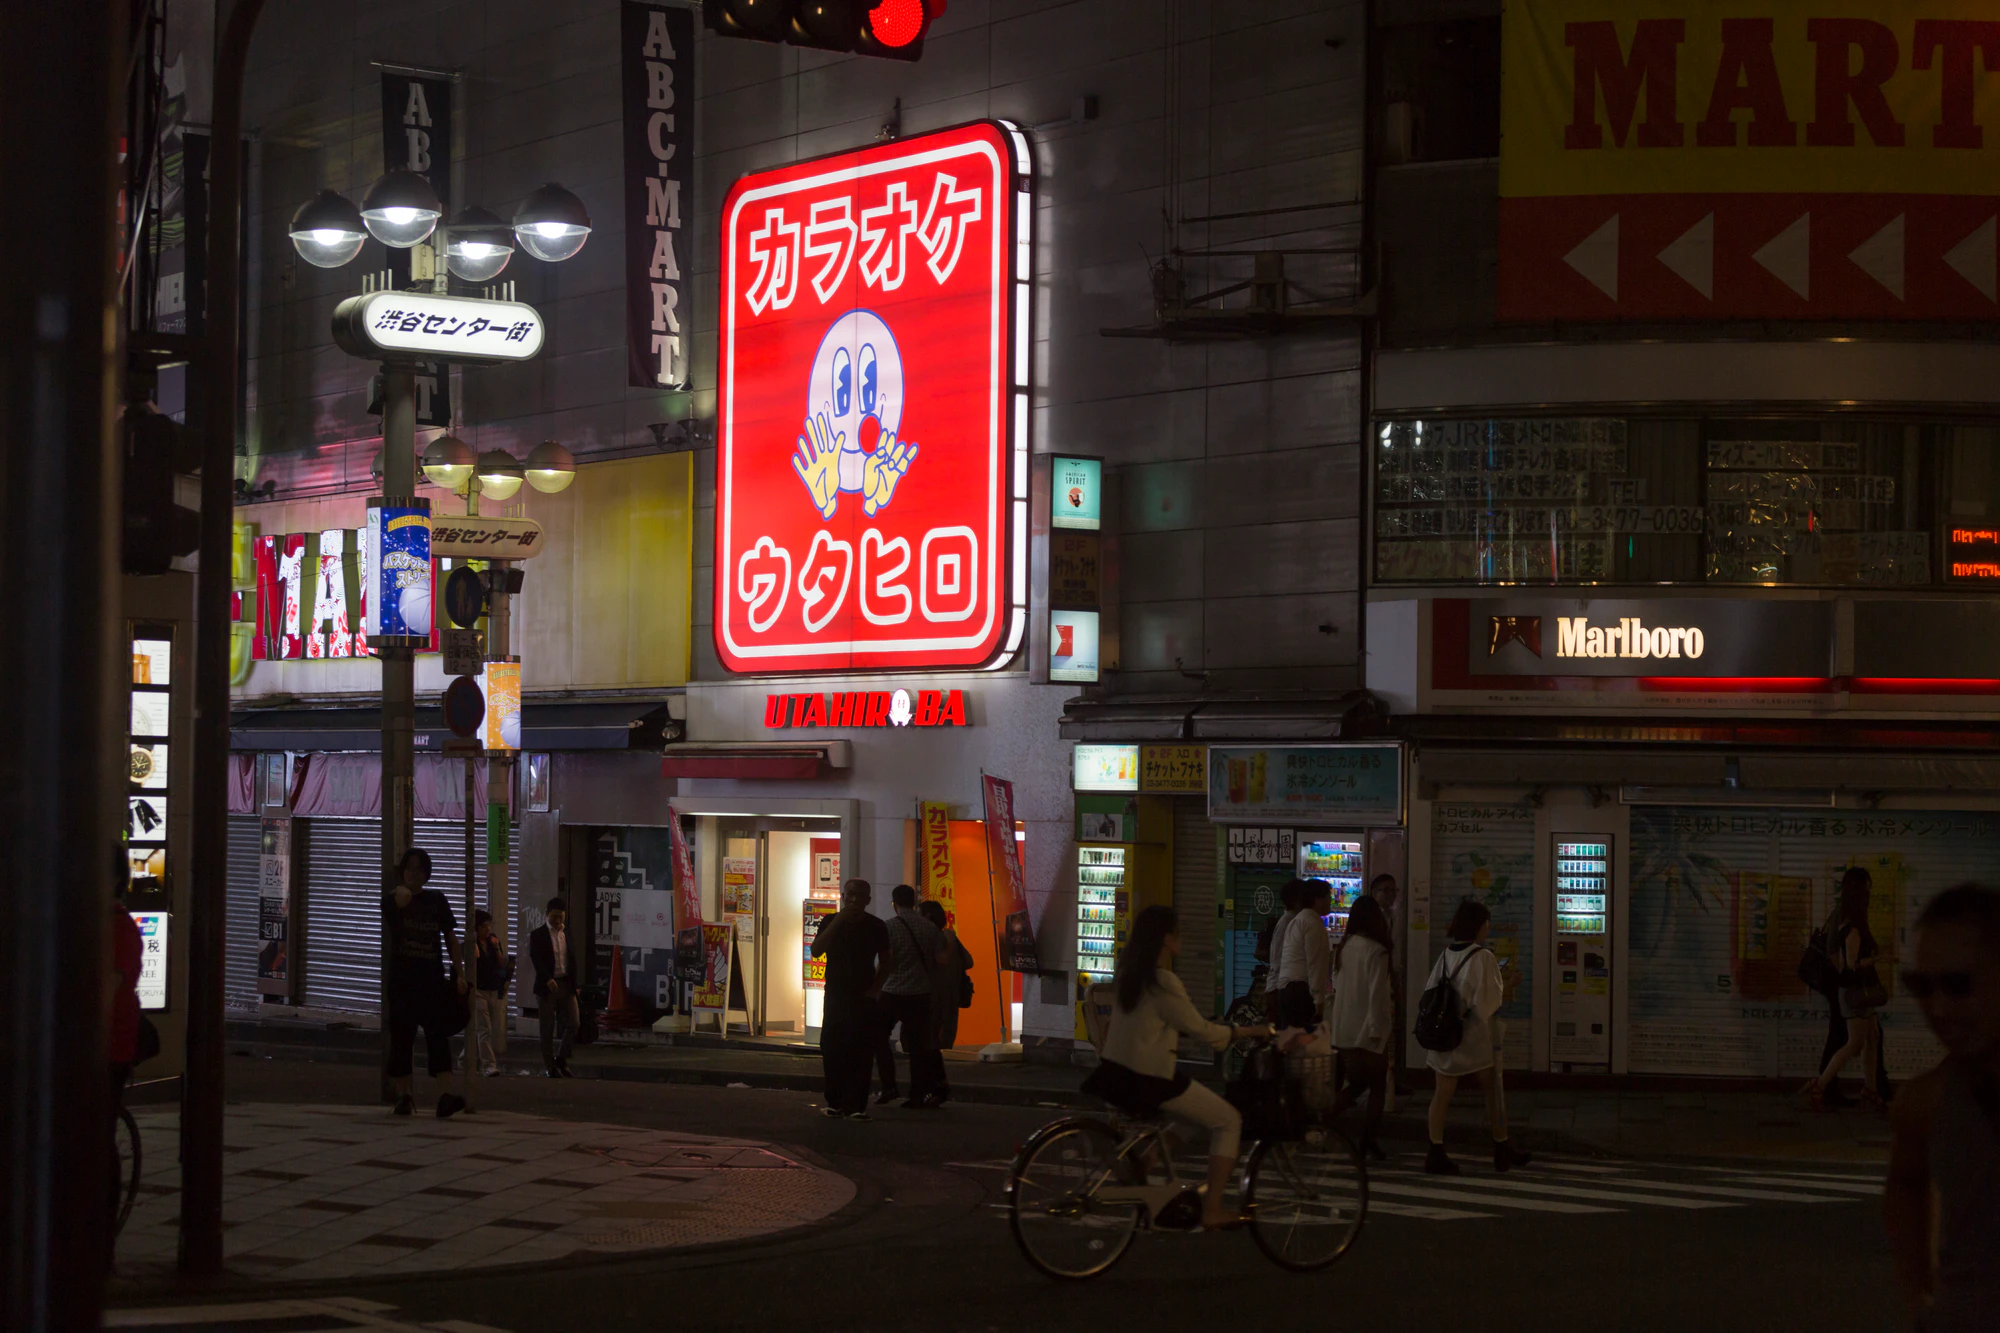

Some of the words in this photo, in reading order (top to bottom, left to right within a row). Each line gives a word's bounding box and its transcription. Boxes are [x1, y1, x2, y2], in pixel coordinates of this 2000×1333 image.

[1564, 17, 2000, 149] MART
[641, 11, 683, 386] ABC-MART
[745, 172, 982, 317] カラオケ
[374, 309, 535, 344] 渋谷センター街
[1609, 480, 1646, 504] TEL
[431, 528, 539, 546] 渋谷センター街
[738, 525, 978, 634] ウタヒロ
[1556, 616, 1704, 659] Marlboro
[928, 806, 951, 879] カラオケ
[1436, 822, 1484, 834] カプセル
